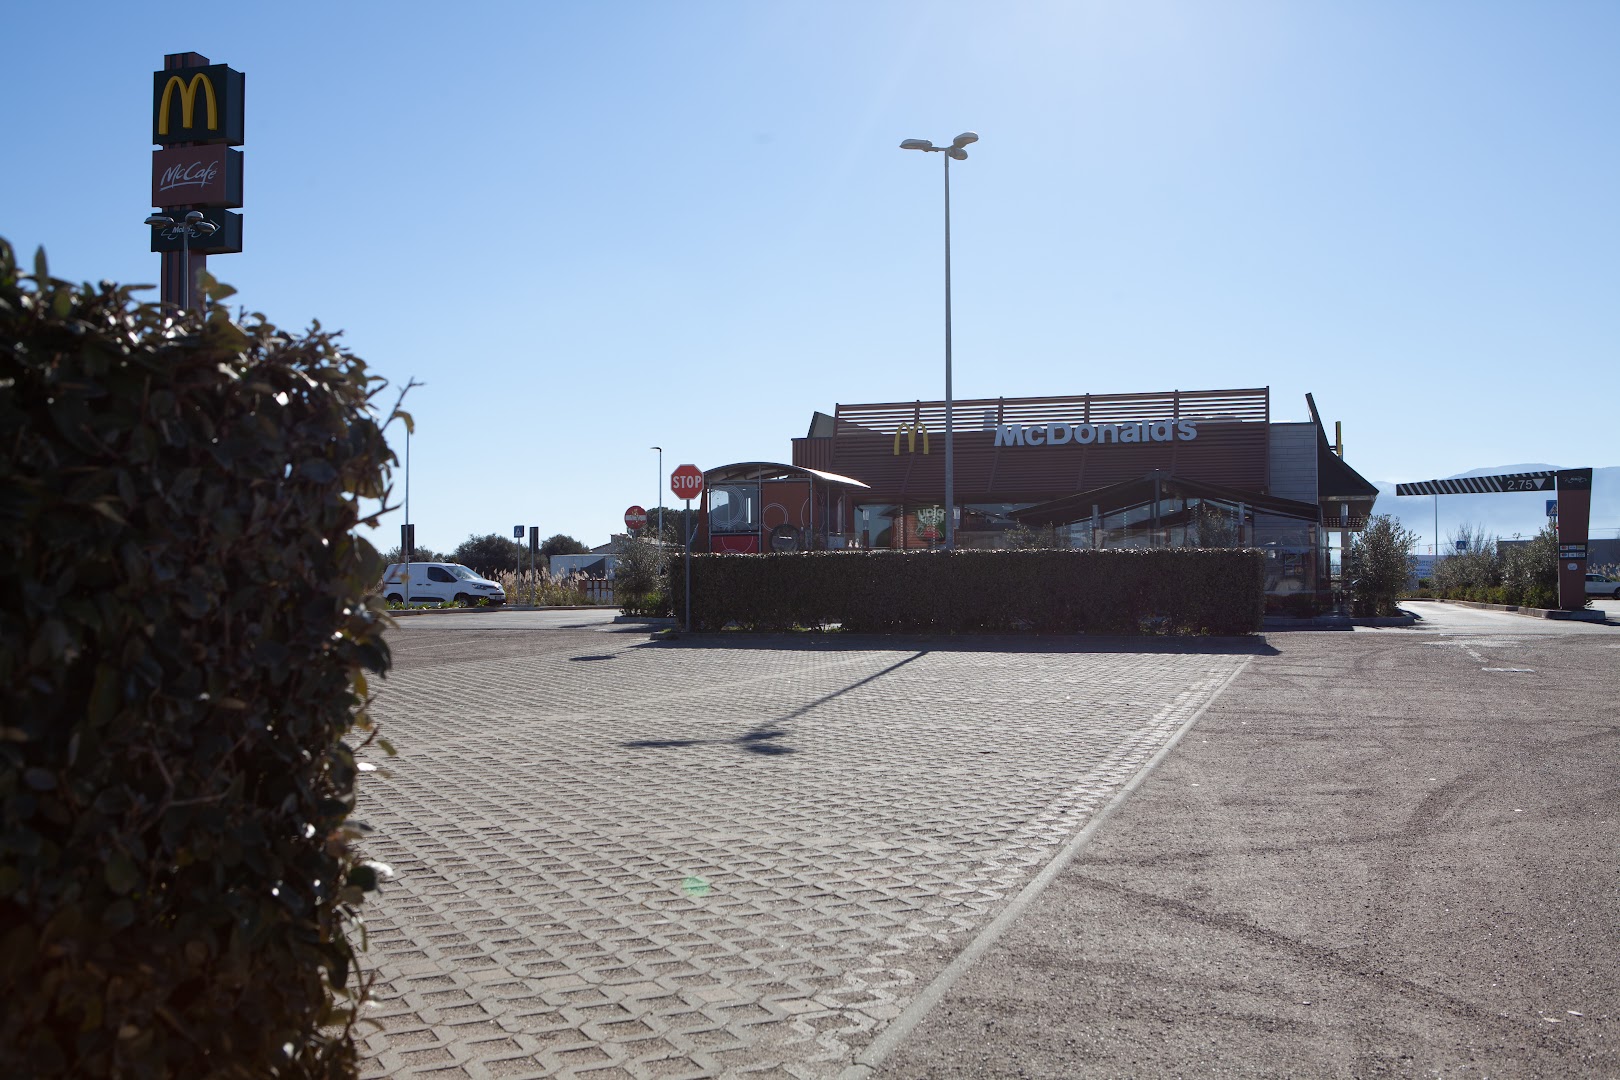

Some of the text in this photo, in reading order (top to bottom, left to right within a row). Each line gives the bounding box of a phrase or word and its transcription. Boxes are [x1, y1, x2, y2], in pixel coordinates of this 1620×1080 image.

[994, 417, 1198, 447] McDonald's
[672, 475, 702, 489] STOP
[1507, 479, 1533, 490] 2.75
